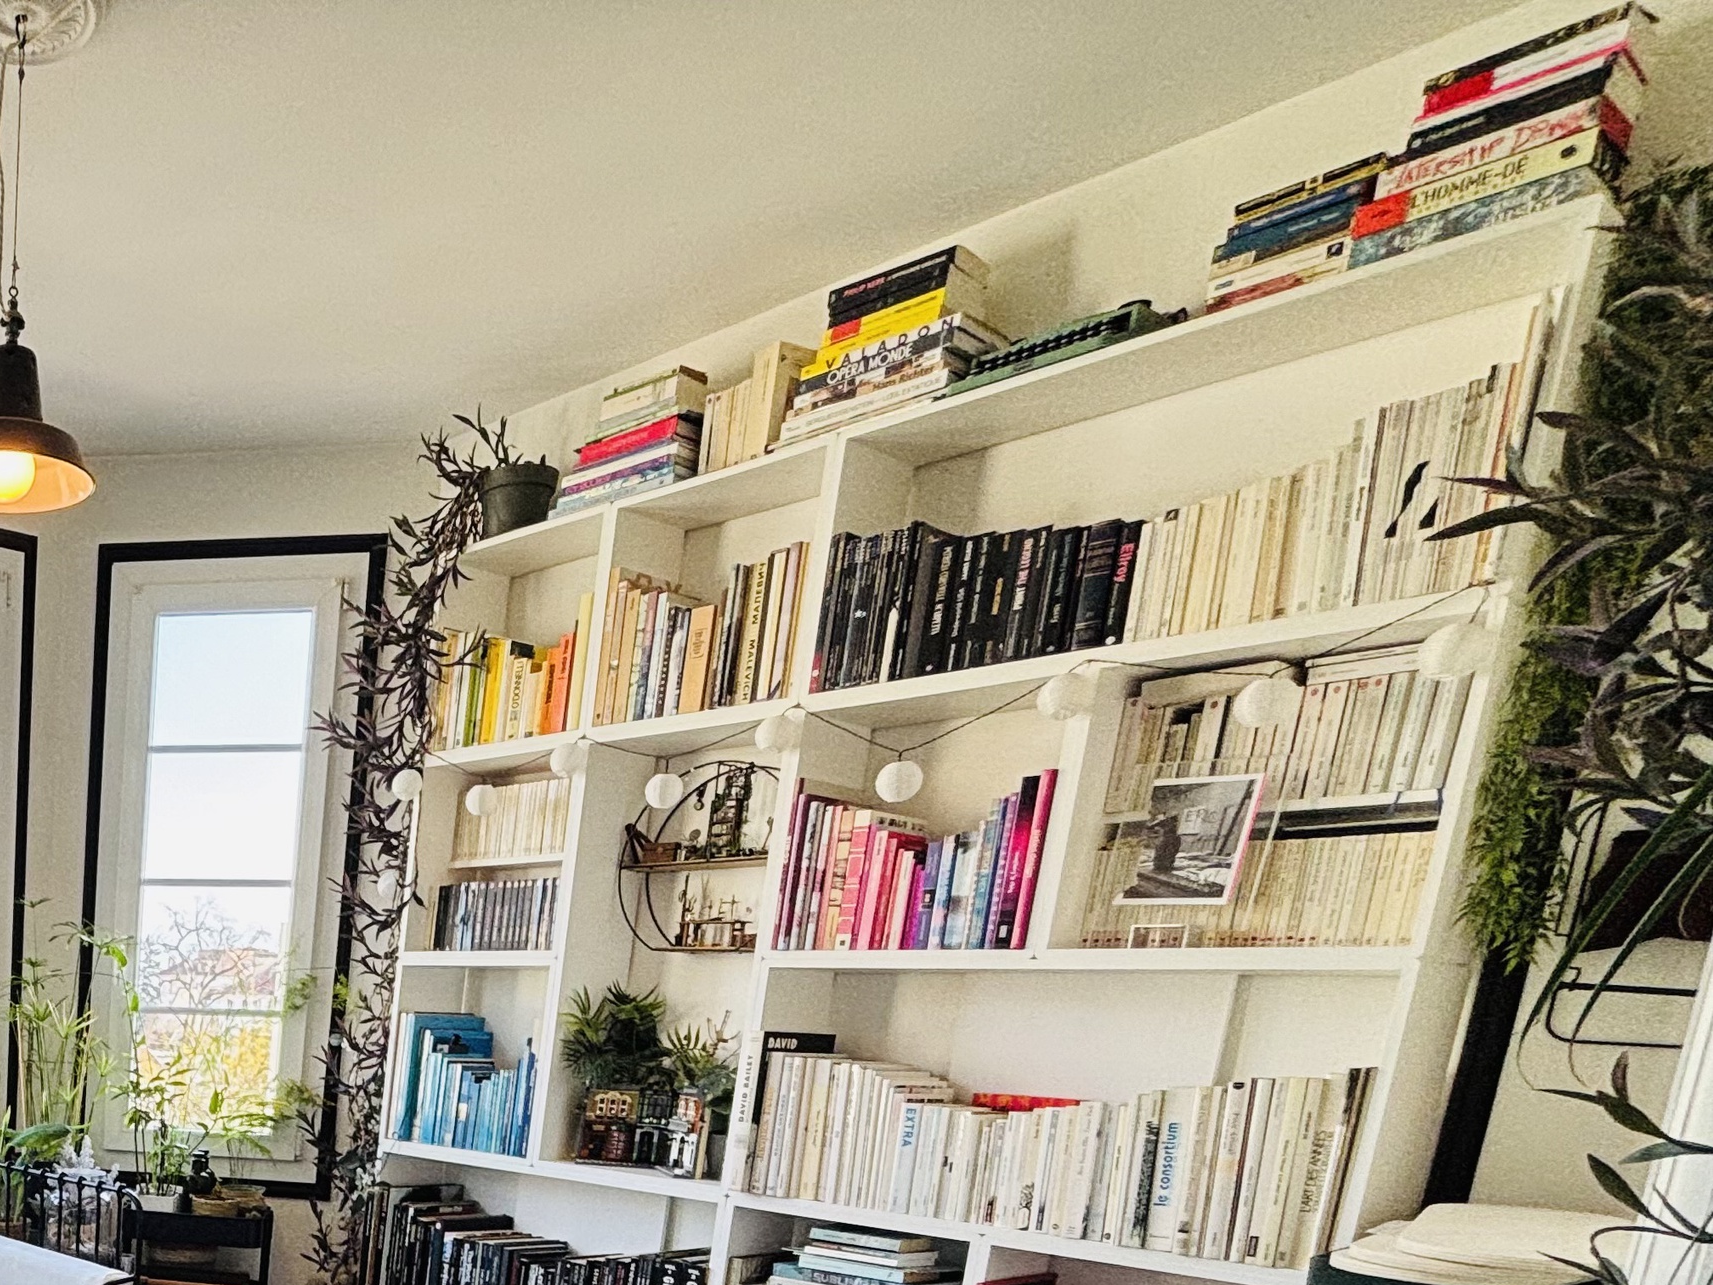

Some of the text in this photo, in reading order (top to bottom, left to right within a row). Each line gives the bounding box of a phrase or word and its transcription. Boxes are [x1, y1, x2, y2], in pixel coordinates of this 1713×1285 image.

[826, 316, 954, 369] VALADON
[827, 344, 913, 384] OPÉRA MONDE
[897, 366, 936, 384] Richter
[741, 639, 756, 702] MALEVICH
[767, 1037, 798, 1050] DAVID
[738, 1054, 754, 1123] DAVID BAILEY
[900, 1107, 917, 1147] EXTRA
[1153, 1122, 1179, 1207] le consortium
